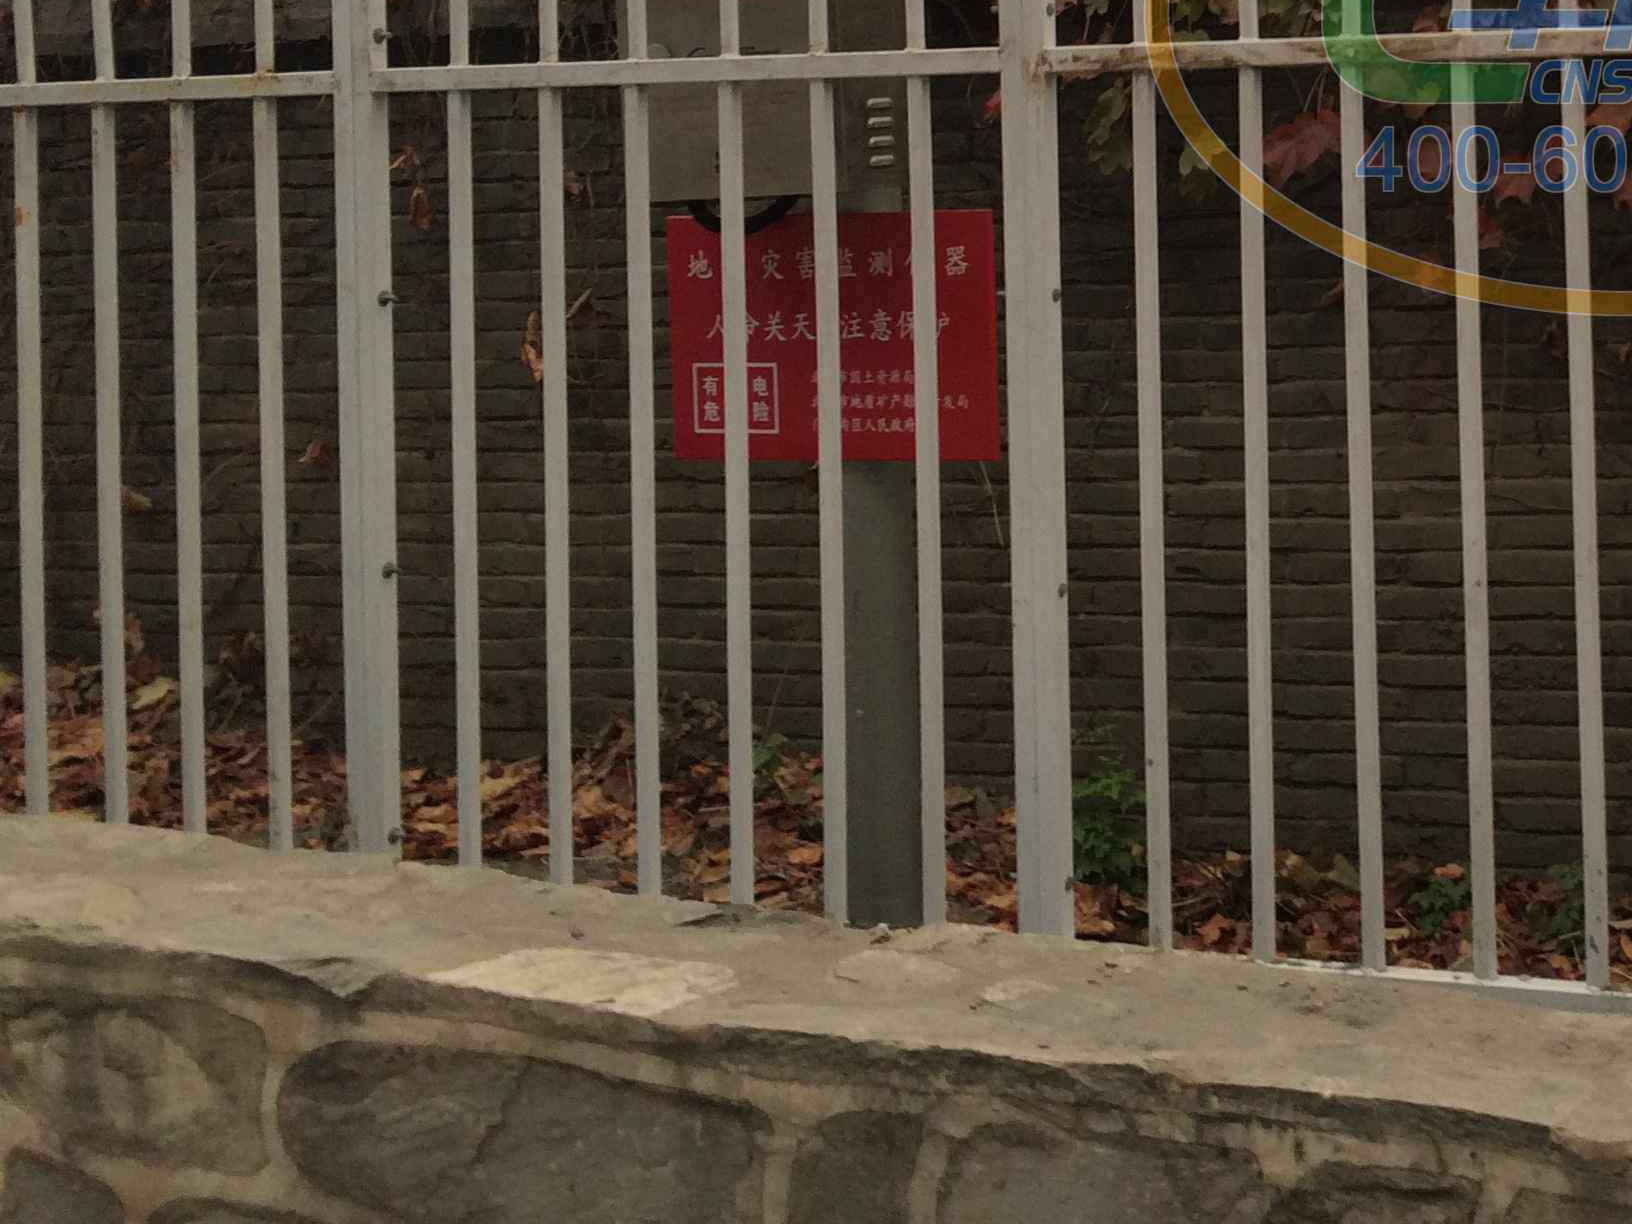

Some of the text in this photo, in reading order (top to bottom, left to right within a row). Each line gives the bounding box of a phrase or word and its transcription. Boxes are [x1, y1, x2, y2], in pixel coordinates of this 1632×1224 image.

[687, 245, 971, 280] 地灾害监测器
